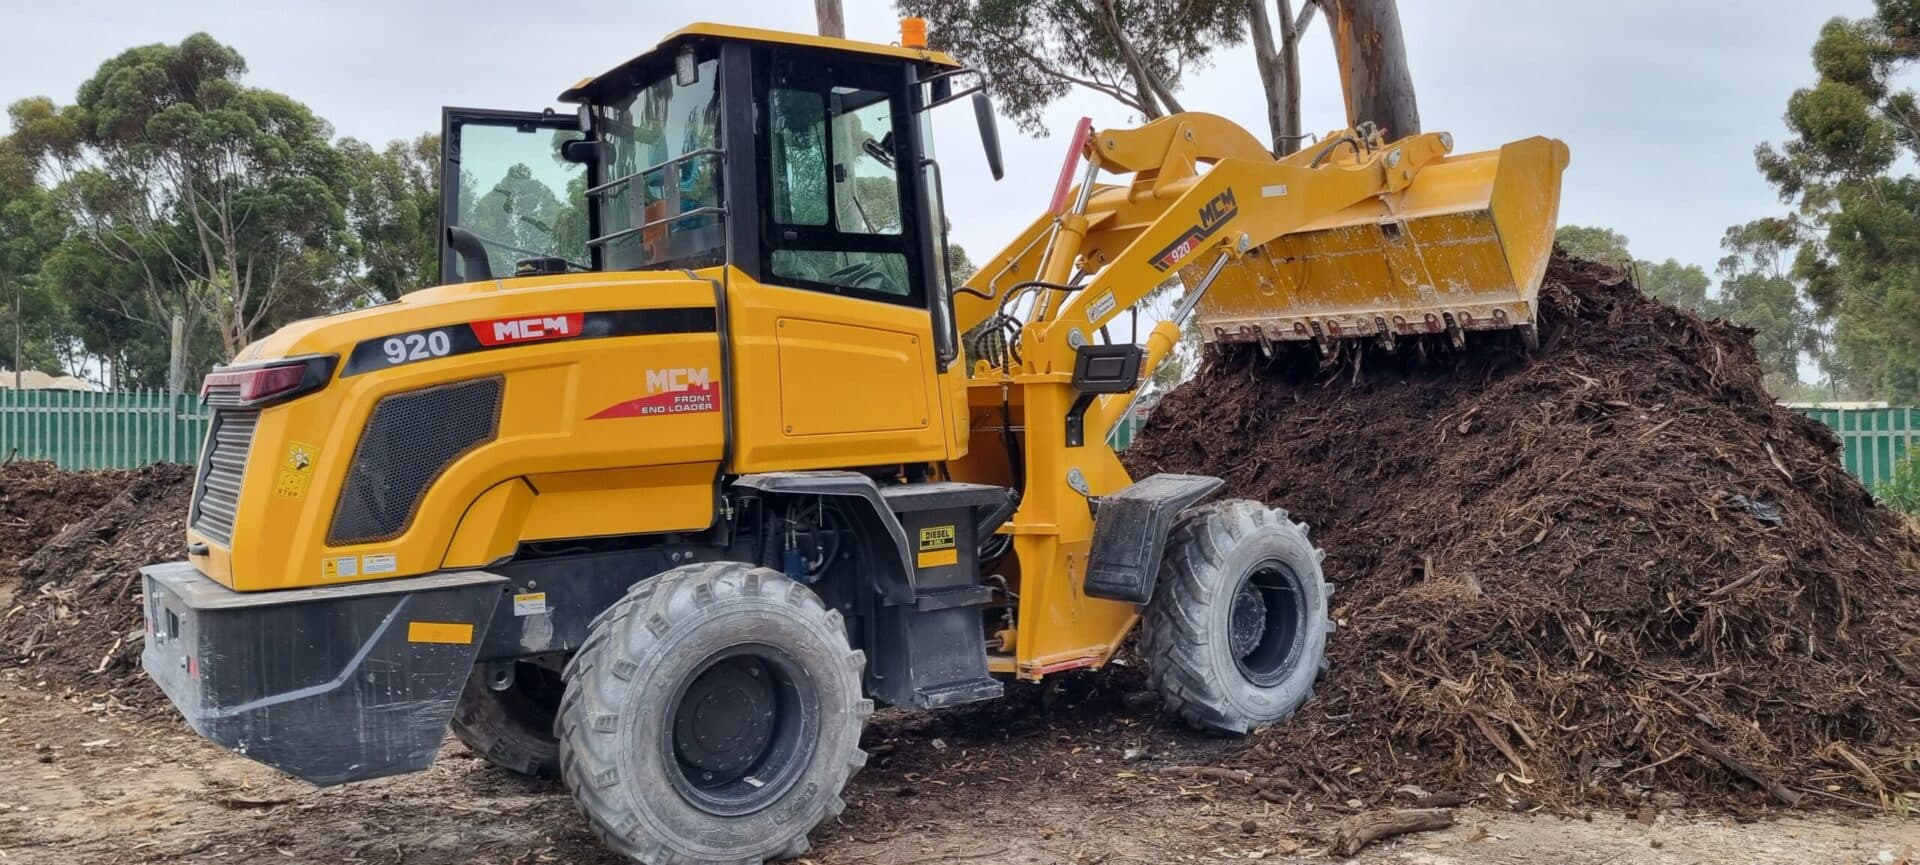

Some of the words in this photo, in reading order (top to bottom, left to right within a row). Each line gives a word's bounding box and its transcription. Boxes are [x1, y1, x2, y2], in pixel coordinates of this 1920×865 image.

[1199, 187, 1236, 228] MCM
[1171, 241, 1191, 262] 920
[493, 316, 568, 341] MCM
[383, 330, 449, 364] 920
[646, 368, 710, 393] MCM
[641, 406, 665, 414] END
[668, 403, 712, 412] LOADER
[674, 395, 712, 403] FRONT
[925, 530, 950, 539] DIESEL
